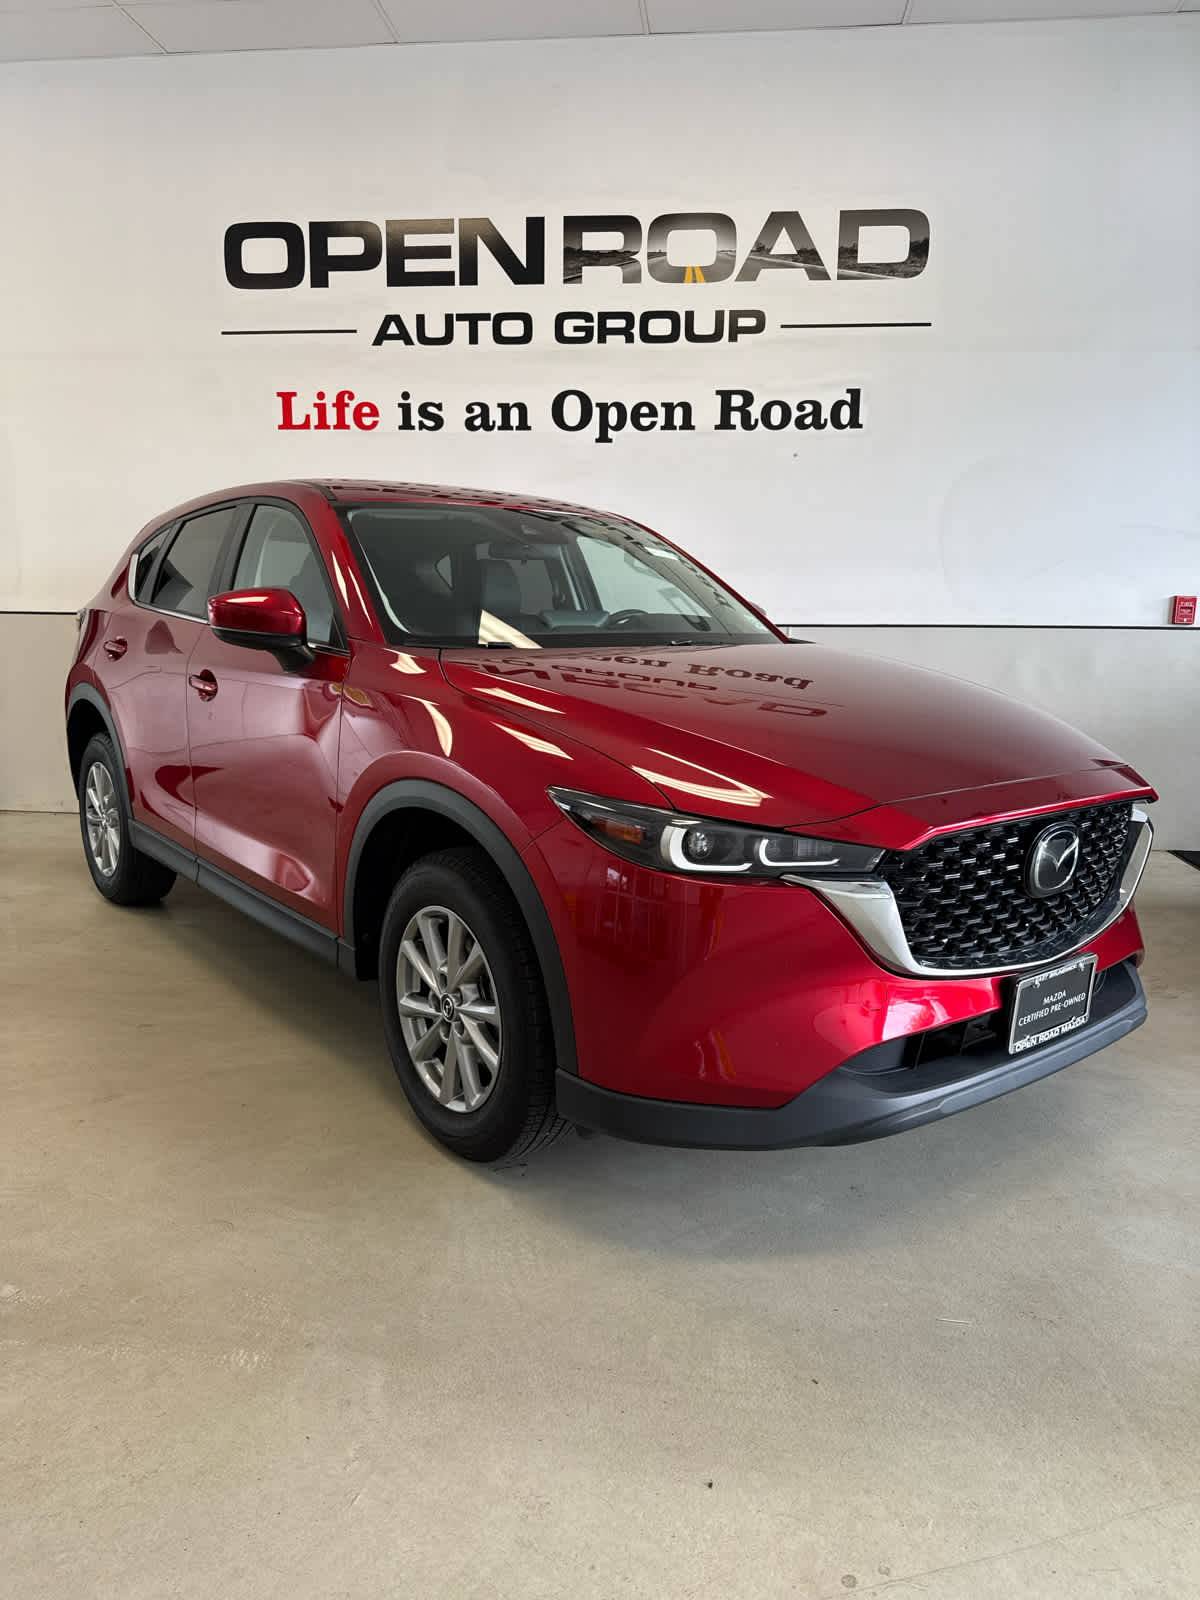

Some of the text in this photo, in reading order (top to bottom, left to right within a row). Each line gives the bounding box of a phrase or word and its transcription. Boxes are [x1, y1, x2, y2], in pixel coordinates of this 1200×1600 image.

[224, 208, 931, 290] OPEN ROAD
[372, 309, 767, 347] AUTO GROUP
[276, 387, 864, 444] Life is an Open Road
[1018, 992, 1086, 1026] CERTIFIED PRE-OWNED
[1043, 989, 1067, 1005] MAZDA
[1015, 1036, 1038, 1052] OPEN
[1038, 1027, 1060, 1043] ROAD
